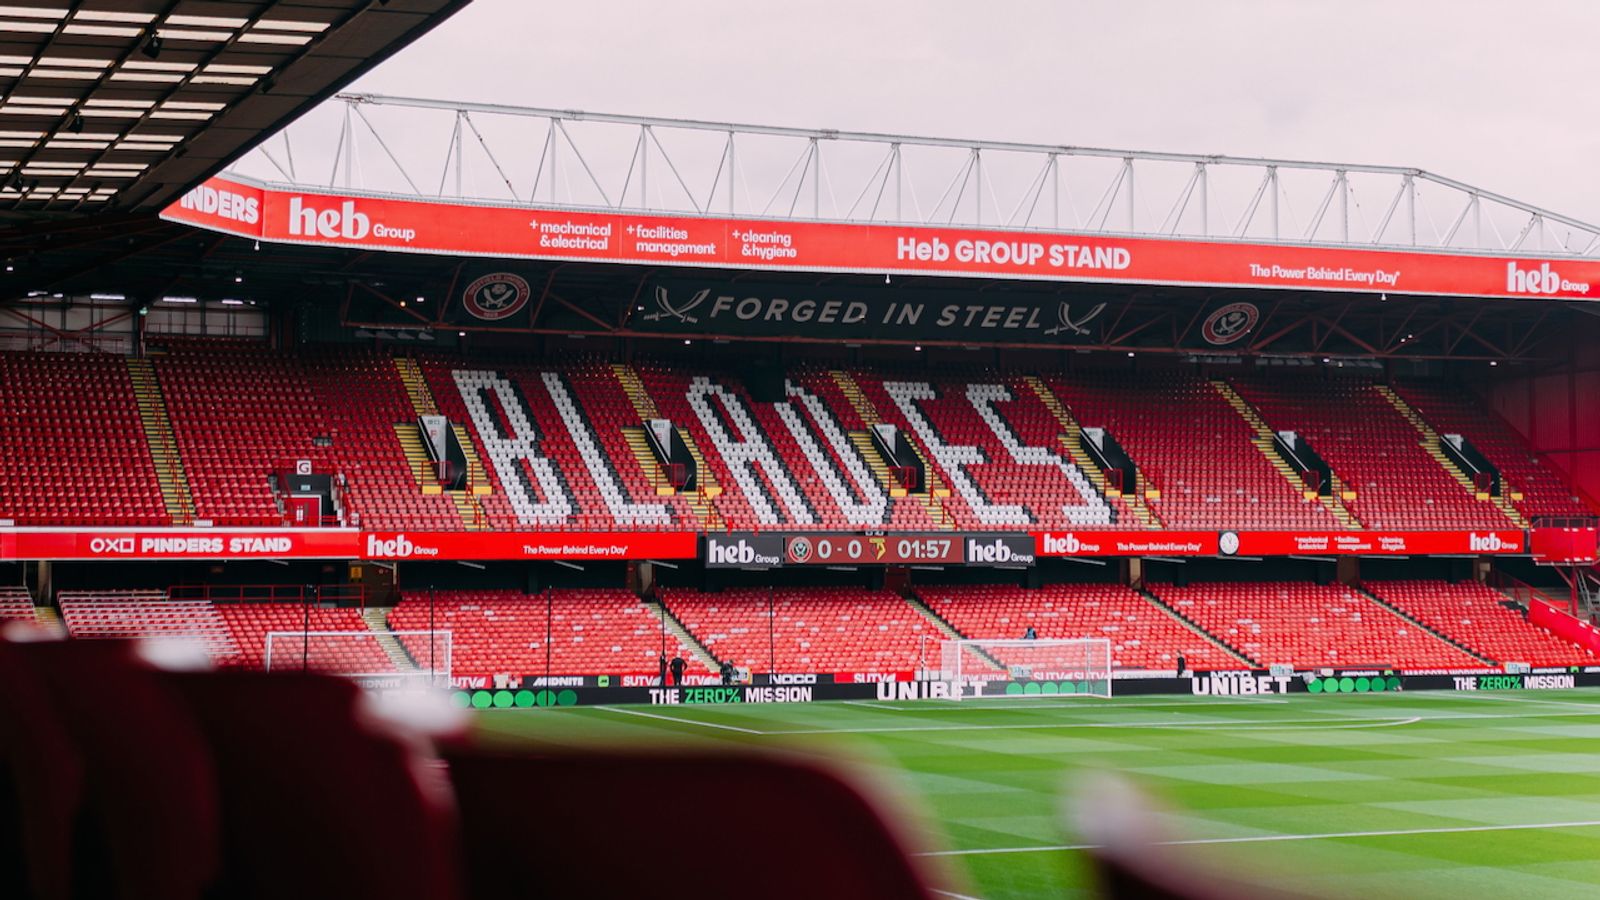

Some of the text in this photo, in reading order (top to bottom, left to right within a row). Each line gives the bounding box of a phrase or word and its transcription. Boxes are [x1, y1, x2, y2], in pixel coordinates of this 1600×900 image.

[289, 197, 415, 241] heb Group
[540, 221, 612, 236] mechanical
[636, 225, 688, 240] facilities
[741, 230, 792, 247] cleaning
[636, 241, 716, 256] management
[897, 237, 1131, 270] Heb GROUP STAND
[1250, 264, 1271, 277] The
[1272, 265, 1306, 279] Power
[1307, 267, 1344, 281] Behind
[1345, 269, 1374, 285] Every
[1507, 262, 1590, 294] heb Group
[709, 296, 1040, 329] FORGED IN STEEL
[298, 462, 310, 474] G
[141, 538, 224, 553] PINDERS
[229, 538, 292, 553] STAND
[367, 534, 439, 557] heb Group
[523, 545, 538, 555] The
[539, 545, 562, 554] Power
[562, 545, 588, 554] Behind
[588, 545, 610, 556] Every
[817, 539, 832, 559] 0
[848, 539, 862, 559] 0
[897, 539, 951, 559] 01:57
[1043, 533, 1100, 554] heb Group
[1470, 532, 1500, 551] heb
[709, 539, 780, 564] heb Group
[968, 539, 1033, 564] heb Group
[1192, 677, 1292, 695] UNIBET
[1453, 675, 1575, 690] THE ZERO% MISSION
[648, 687, 812, 704] THE ZERO% MISSION
